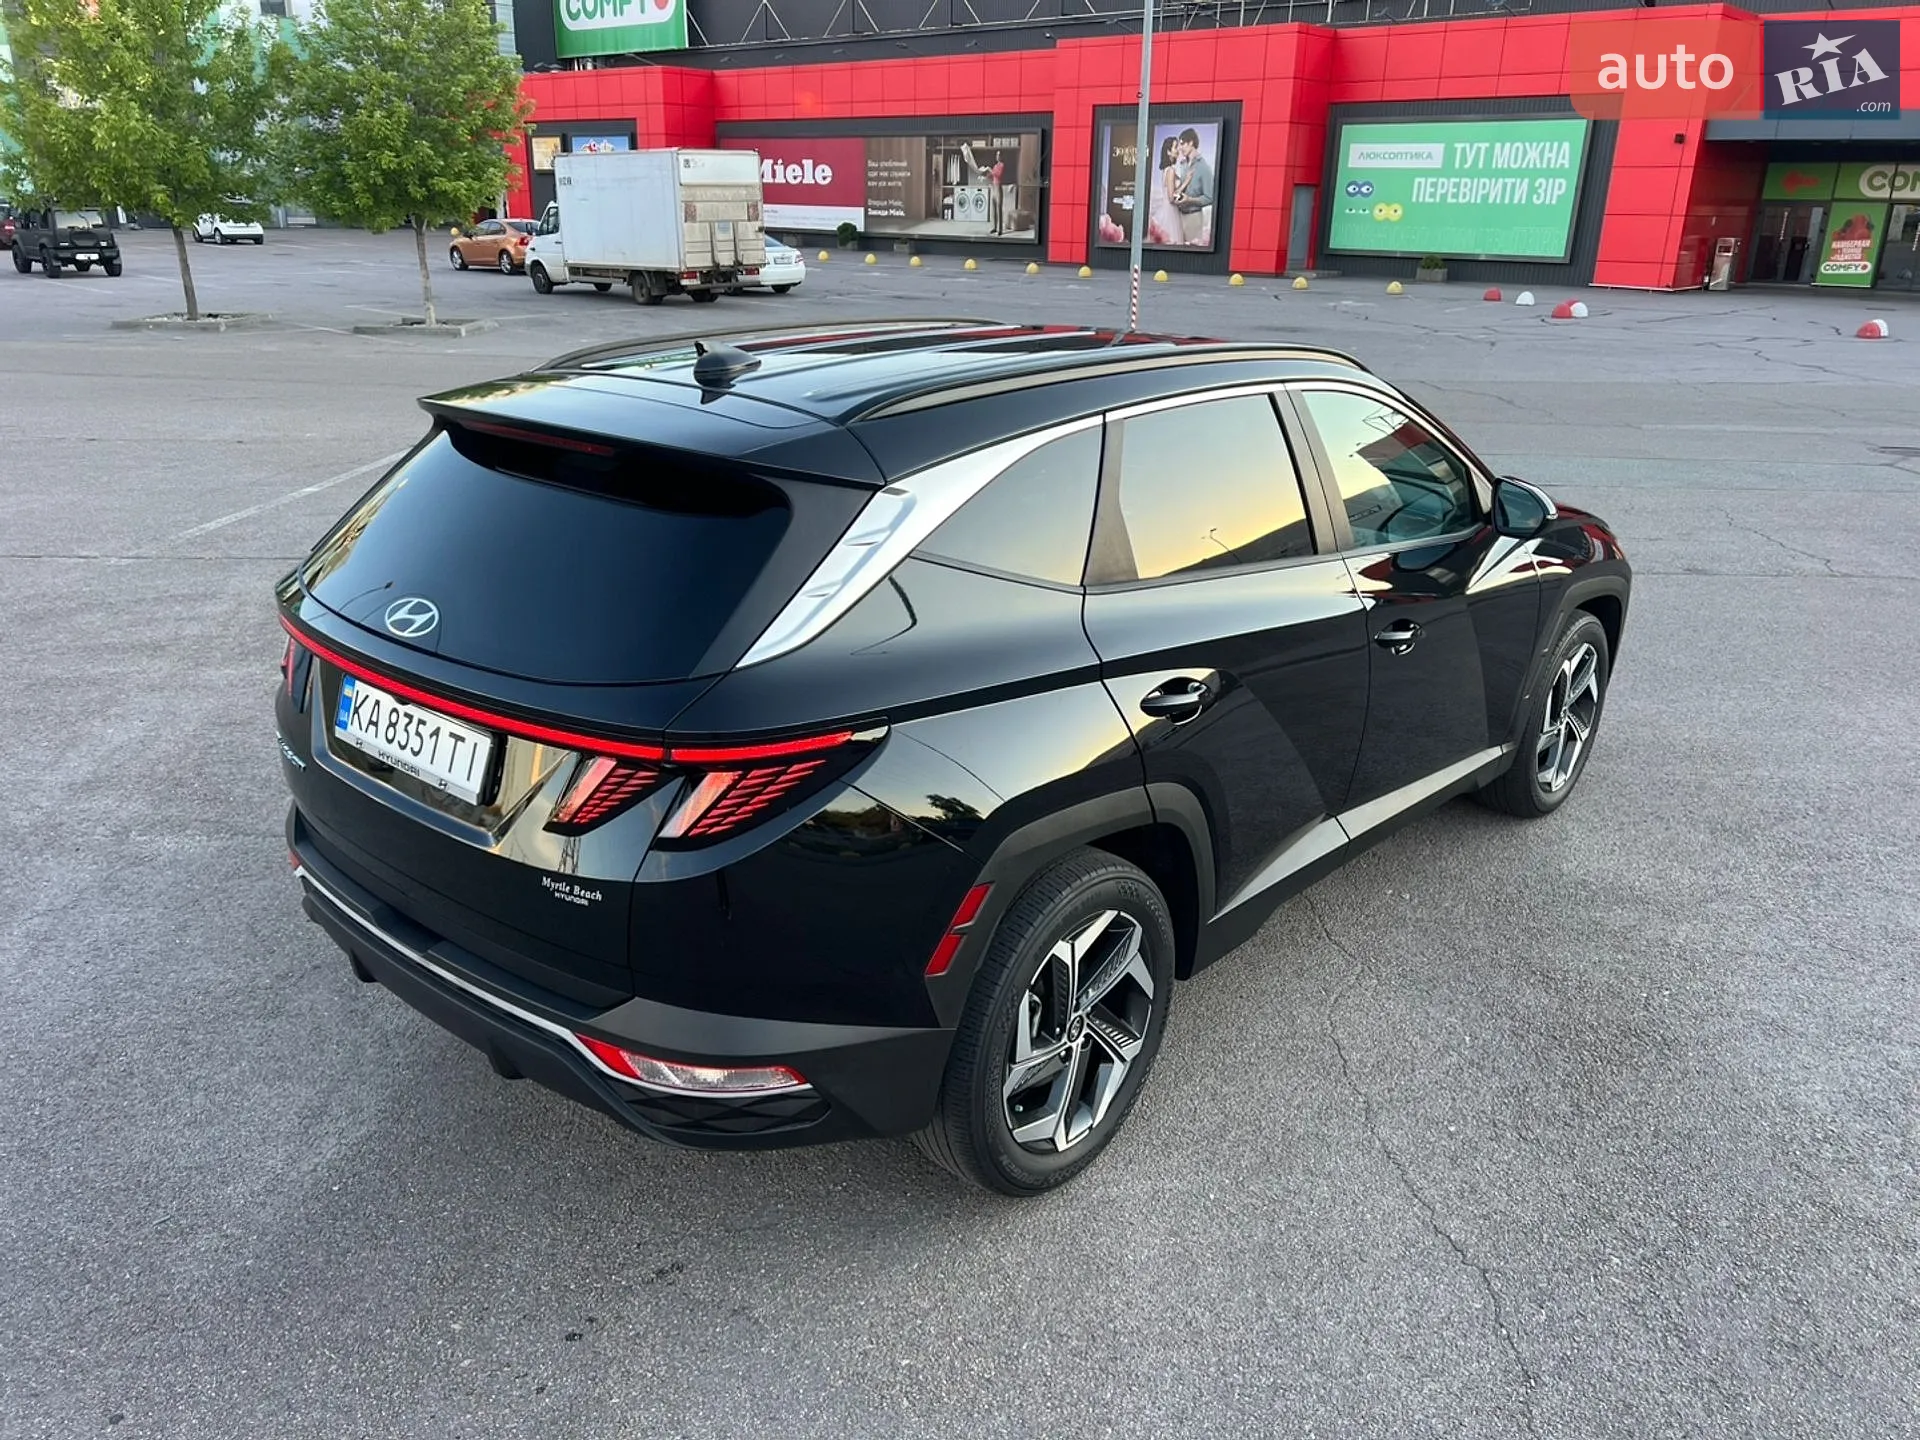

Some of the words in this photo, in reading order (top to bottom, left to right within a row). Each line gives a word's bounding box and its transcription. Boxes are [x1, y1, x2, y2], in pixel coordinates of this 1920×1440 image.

[1453, 143, 1490, 169] ТУТ
[1492, 142, 1570, 169] МОЖНА
[1412, 177, 1529, 204] ПЕРЕВІРИТИ
[1532, 178, 1567, 205] ЗІР
[1823, 263, 1861, 273] COMFY
[377, 750, 420, 777] HYUNDAI
[541, 876, 571, 894] Myrtle
[573, 885, 603, 902] Beach
